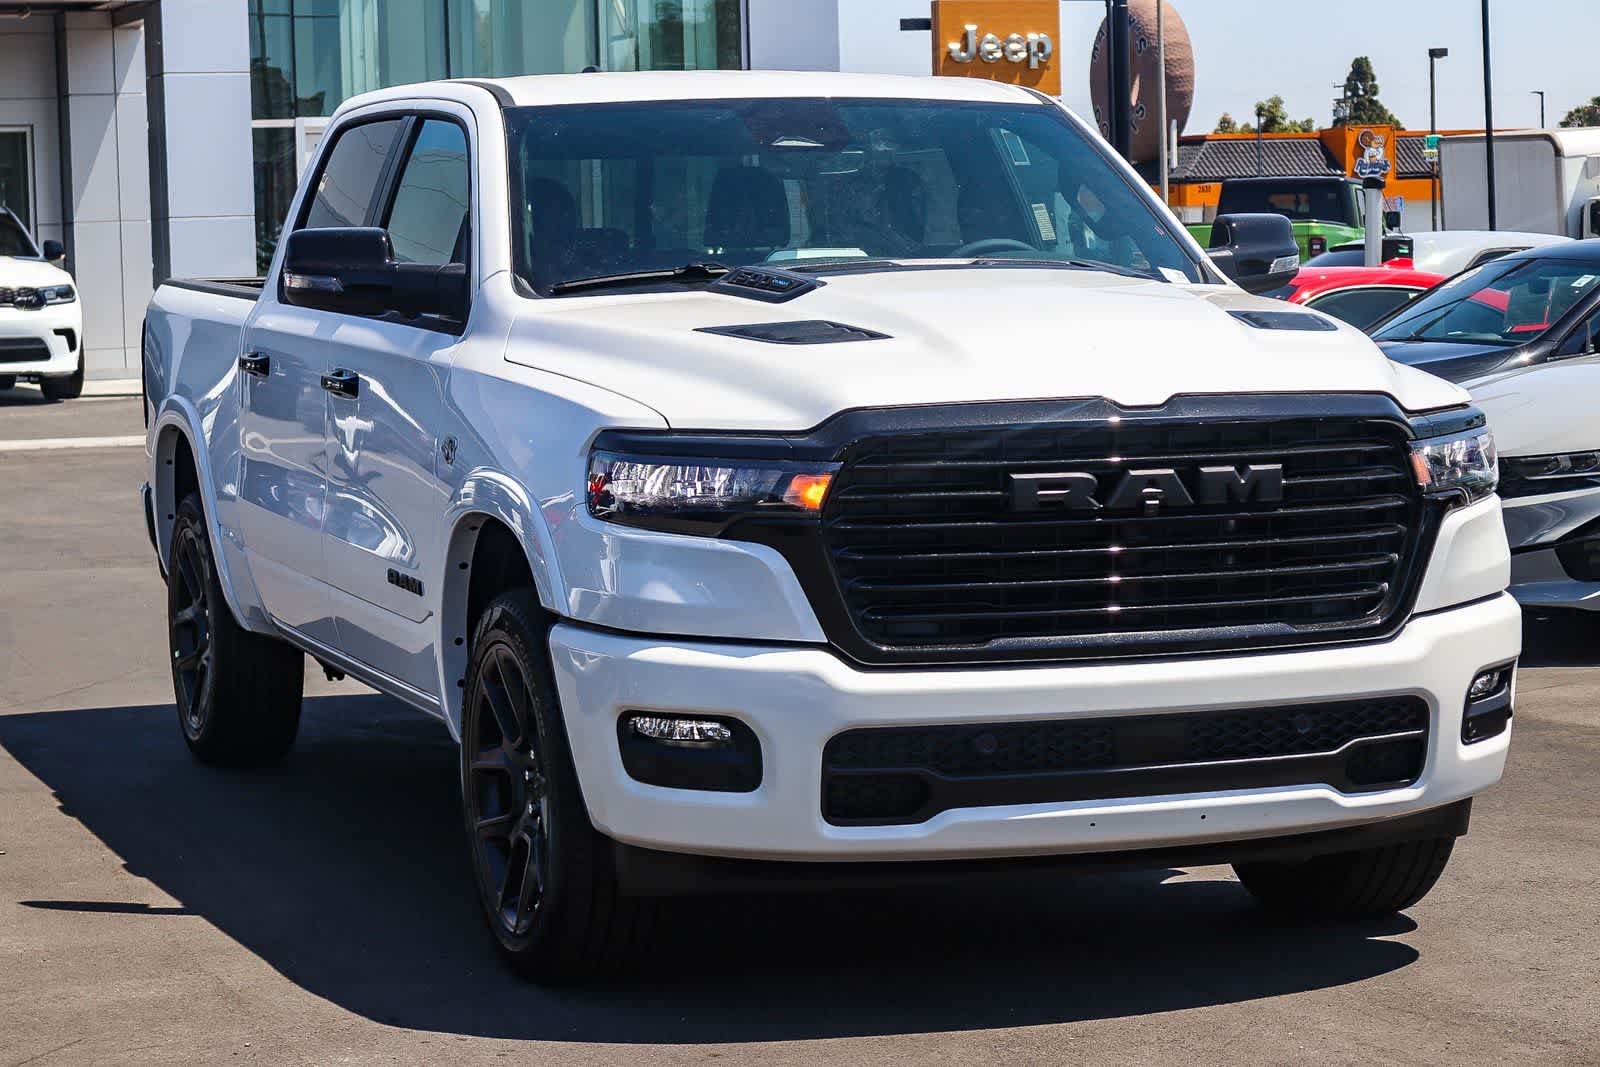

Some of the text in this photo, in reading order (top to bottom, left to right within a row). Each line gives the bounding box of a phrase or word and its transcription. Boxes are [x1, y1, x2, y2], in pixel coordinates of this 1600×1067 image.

[947, 24, 1052, 69] Jeep
[1009, 463, 1283, 513] RAM
[387, 567, 423, 597] RAM
